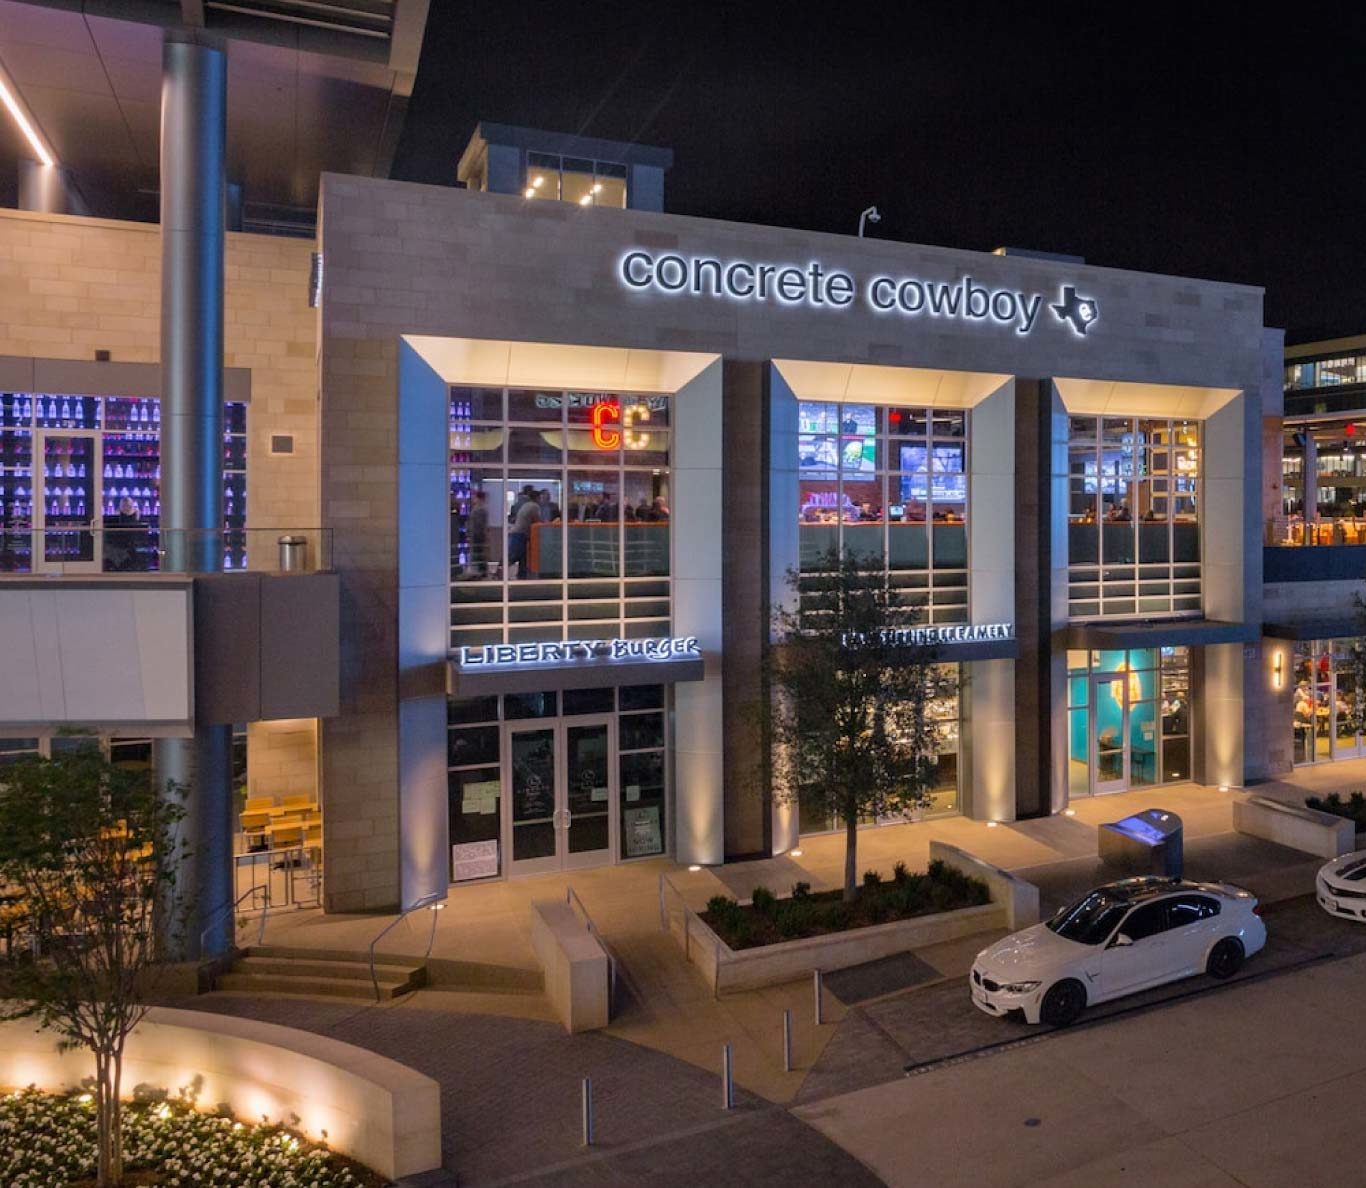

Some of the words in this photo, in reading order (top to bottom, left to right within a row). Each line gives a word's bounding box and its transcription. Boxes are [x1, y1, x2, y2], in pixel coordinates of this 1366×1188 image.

[621, 250, 854, 306] concrete
[869, 277, 1042, 333] cowboy
[461, 640, 604, 666] LIBERTY
[611, 636, 702, 661] BURGER
